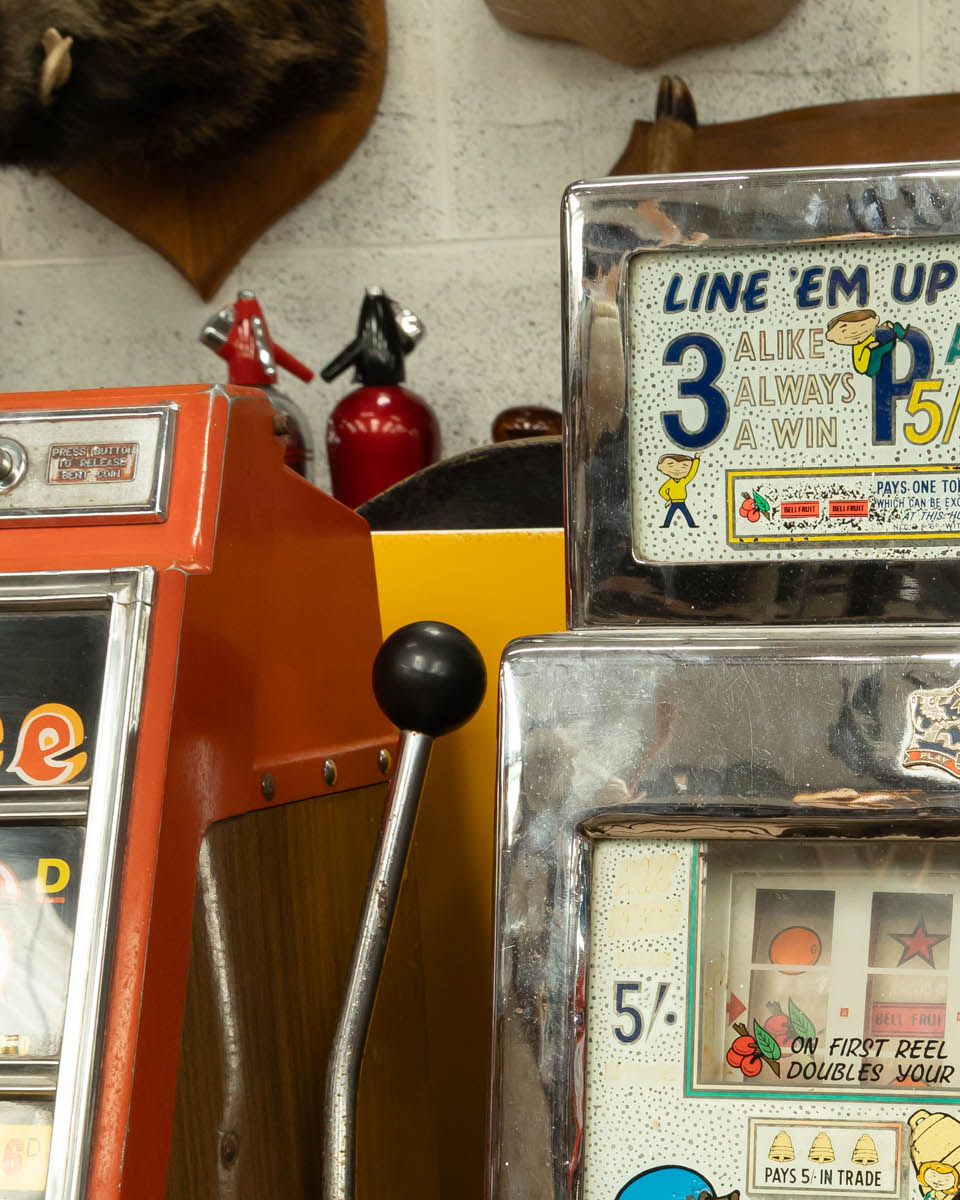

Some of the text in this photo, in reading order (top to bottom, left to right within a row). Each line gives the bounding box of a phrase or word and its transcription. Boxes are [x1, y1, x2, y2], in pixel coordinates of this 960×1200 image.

[662, 259, 958, 314] LINE 'EM UP
[734, 328, 827, 363] ALIKE
[659, 331, 730, 450] 3
[733, 371, 857, 408] ALWAYS
[733, 416, 838, 450] A WIN
[52, 447, 87, 457] PRESS
[59, 458, 126, 468] TO RELEASE
[62, 469, 121, 480] BENT COIN
[877, 480, 907, 495] PAYS
[912, 480, 937, 494] ONE
[877, 498, 905, 508] WHICH
[908, 497, 926, 508] CAN
[930, 496, 941, 507] BE
[902, 511, 916, 521] AT
[920, 511, 943, 521] THIS
[920, 751, 947, 764] PLAY
[875, 1014, 904, 1026] BELL
[790, 1036, 949, 1060] ON FIRST REEL
[786, 1060, 884, 1083] DOUBLES
[896, 1065, 956, 1085] YOUR
[764, 1167, 797, 1184] PAYS
[820, 1169, 833, 1185] IN
[838, 1170, 882, 1187] TRADE
